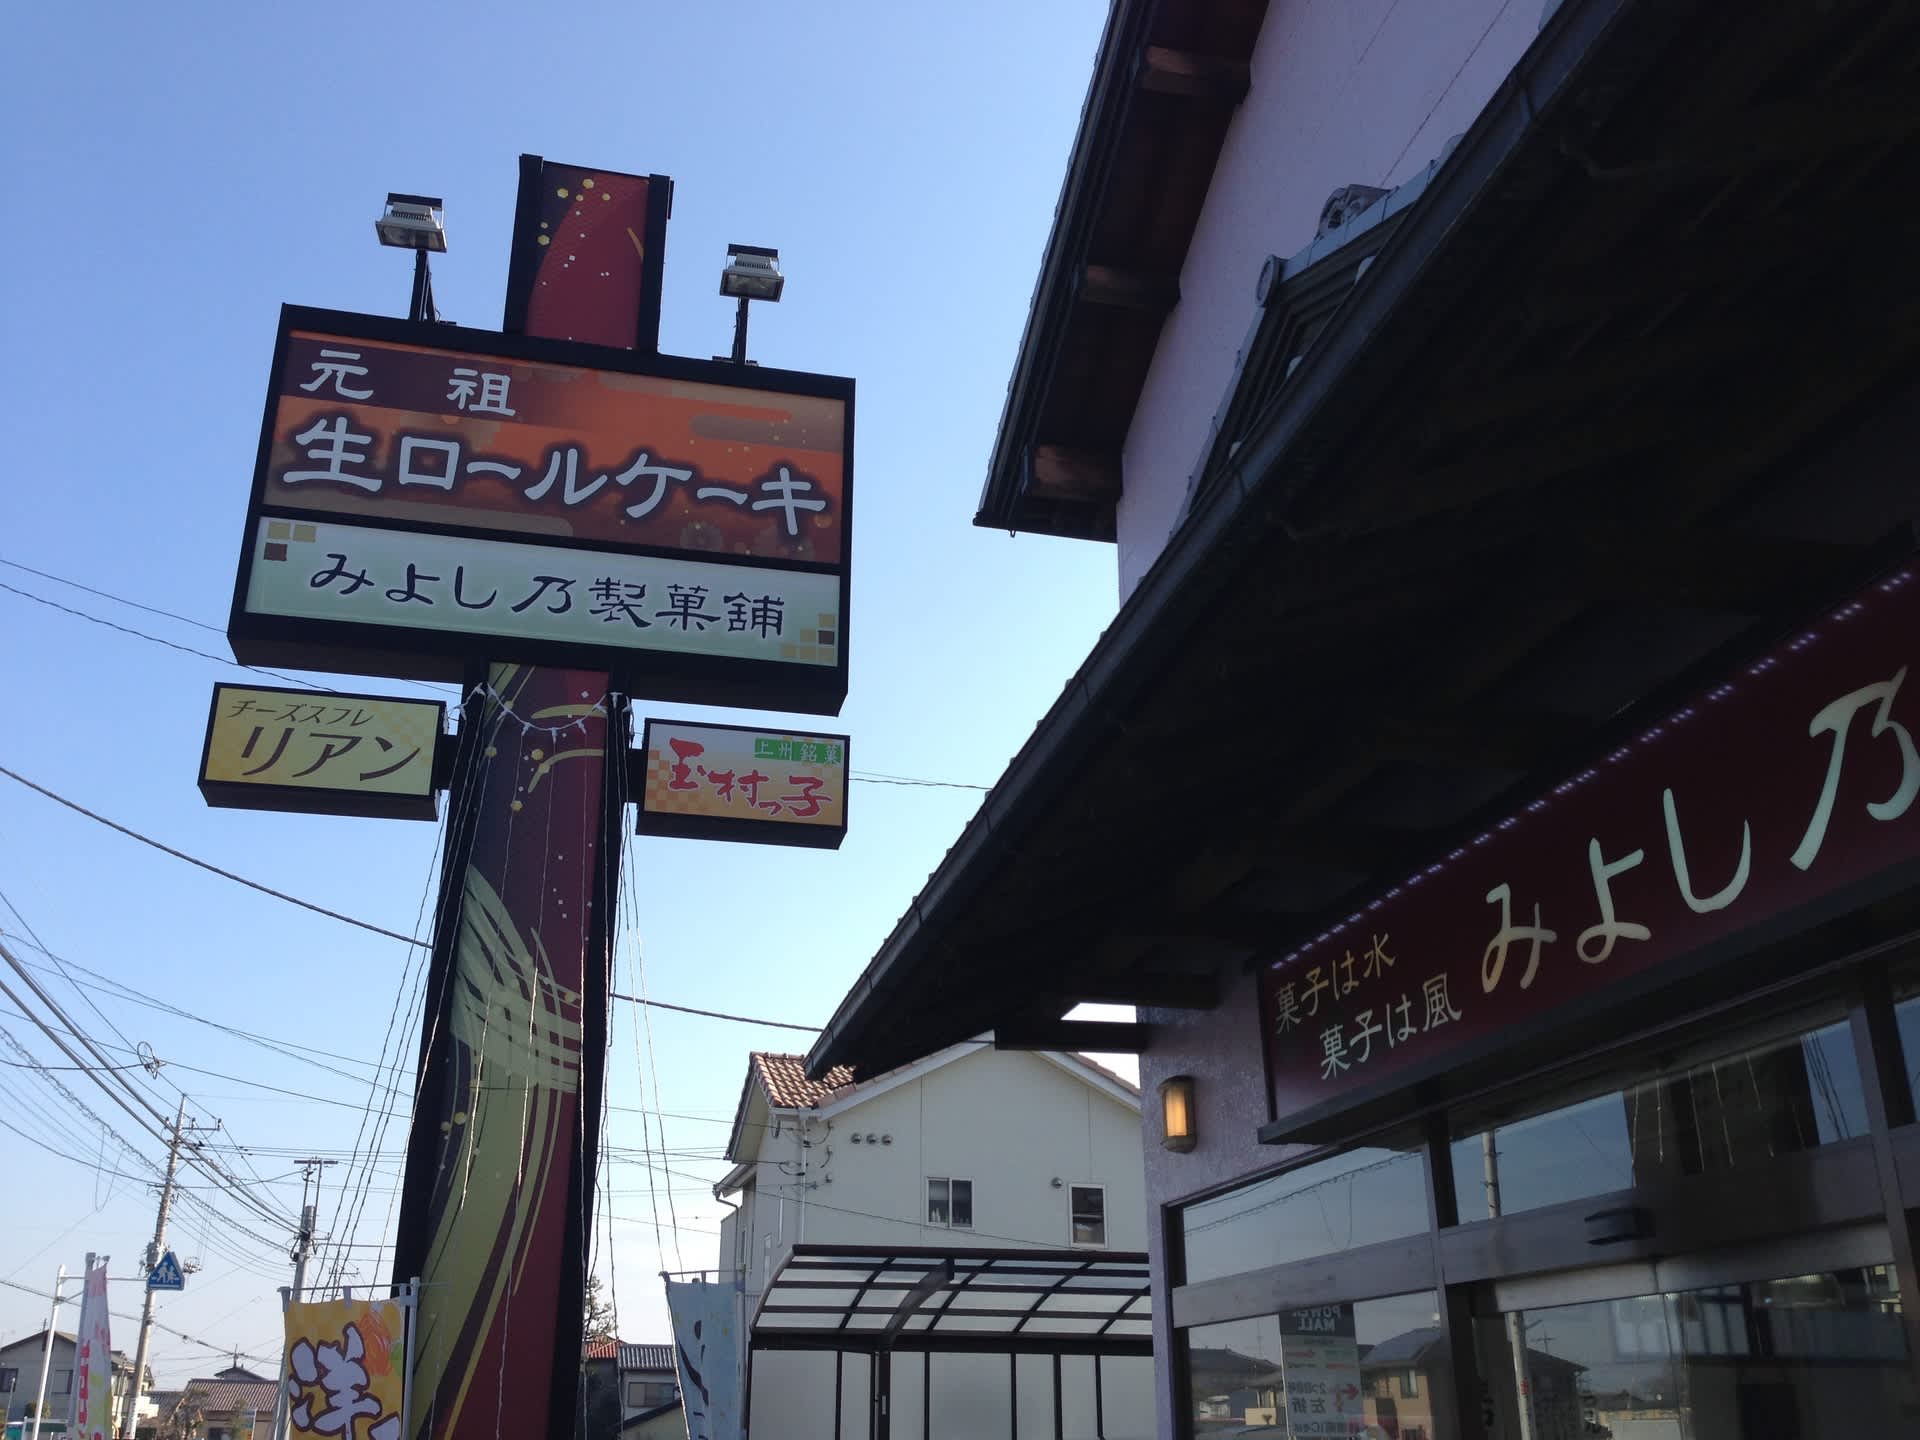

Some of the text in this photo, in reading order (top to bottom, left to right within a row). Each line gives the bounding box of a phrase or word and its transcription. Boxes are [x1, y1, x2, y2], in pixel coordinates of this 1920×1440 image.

[283, 416, 827, 535] 生ロールケーキ
[309, 553, 785, 640] みよし乃製菓舗
[226, 700, 376, 727] チーズスフレ
[241, 726, 421, 782] リアン
[757, 741, 840, 765] 上州銘菓
[668, 737, 833, 817] 玉村っ子
[1480, 661, 1920, 994] みよし乃
[1274, 932, 1397, 1035] 菓子は水
[1319, 971, 1463, 1081] 菓子は風
